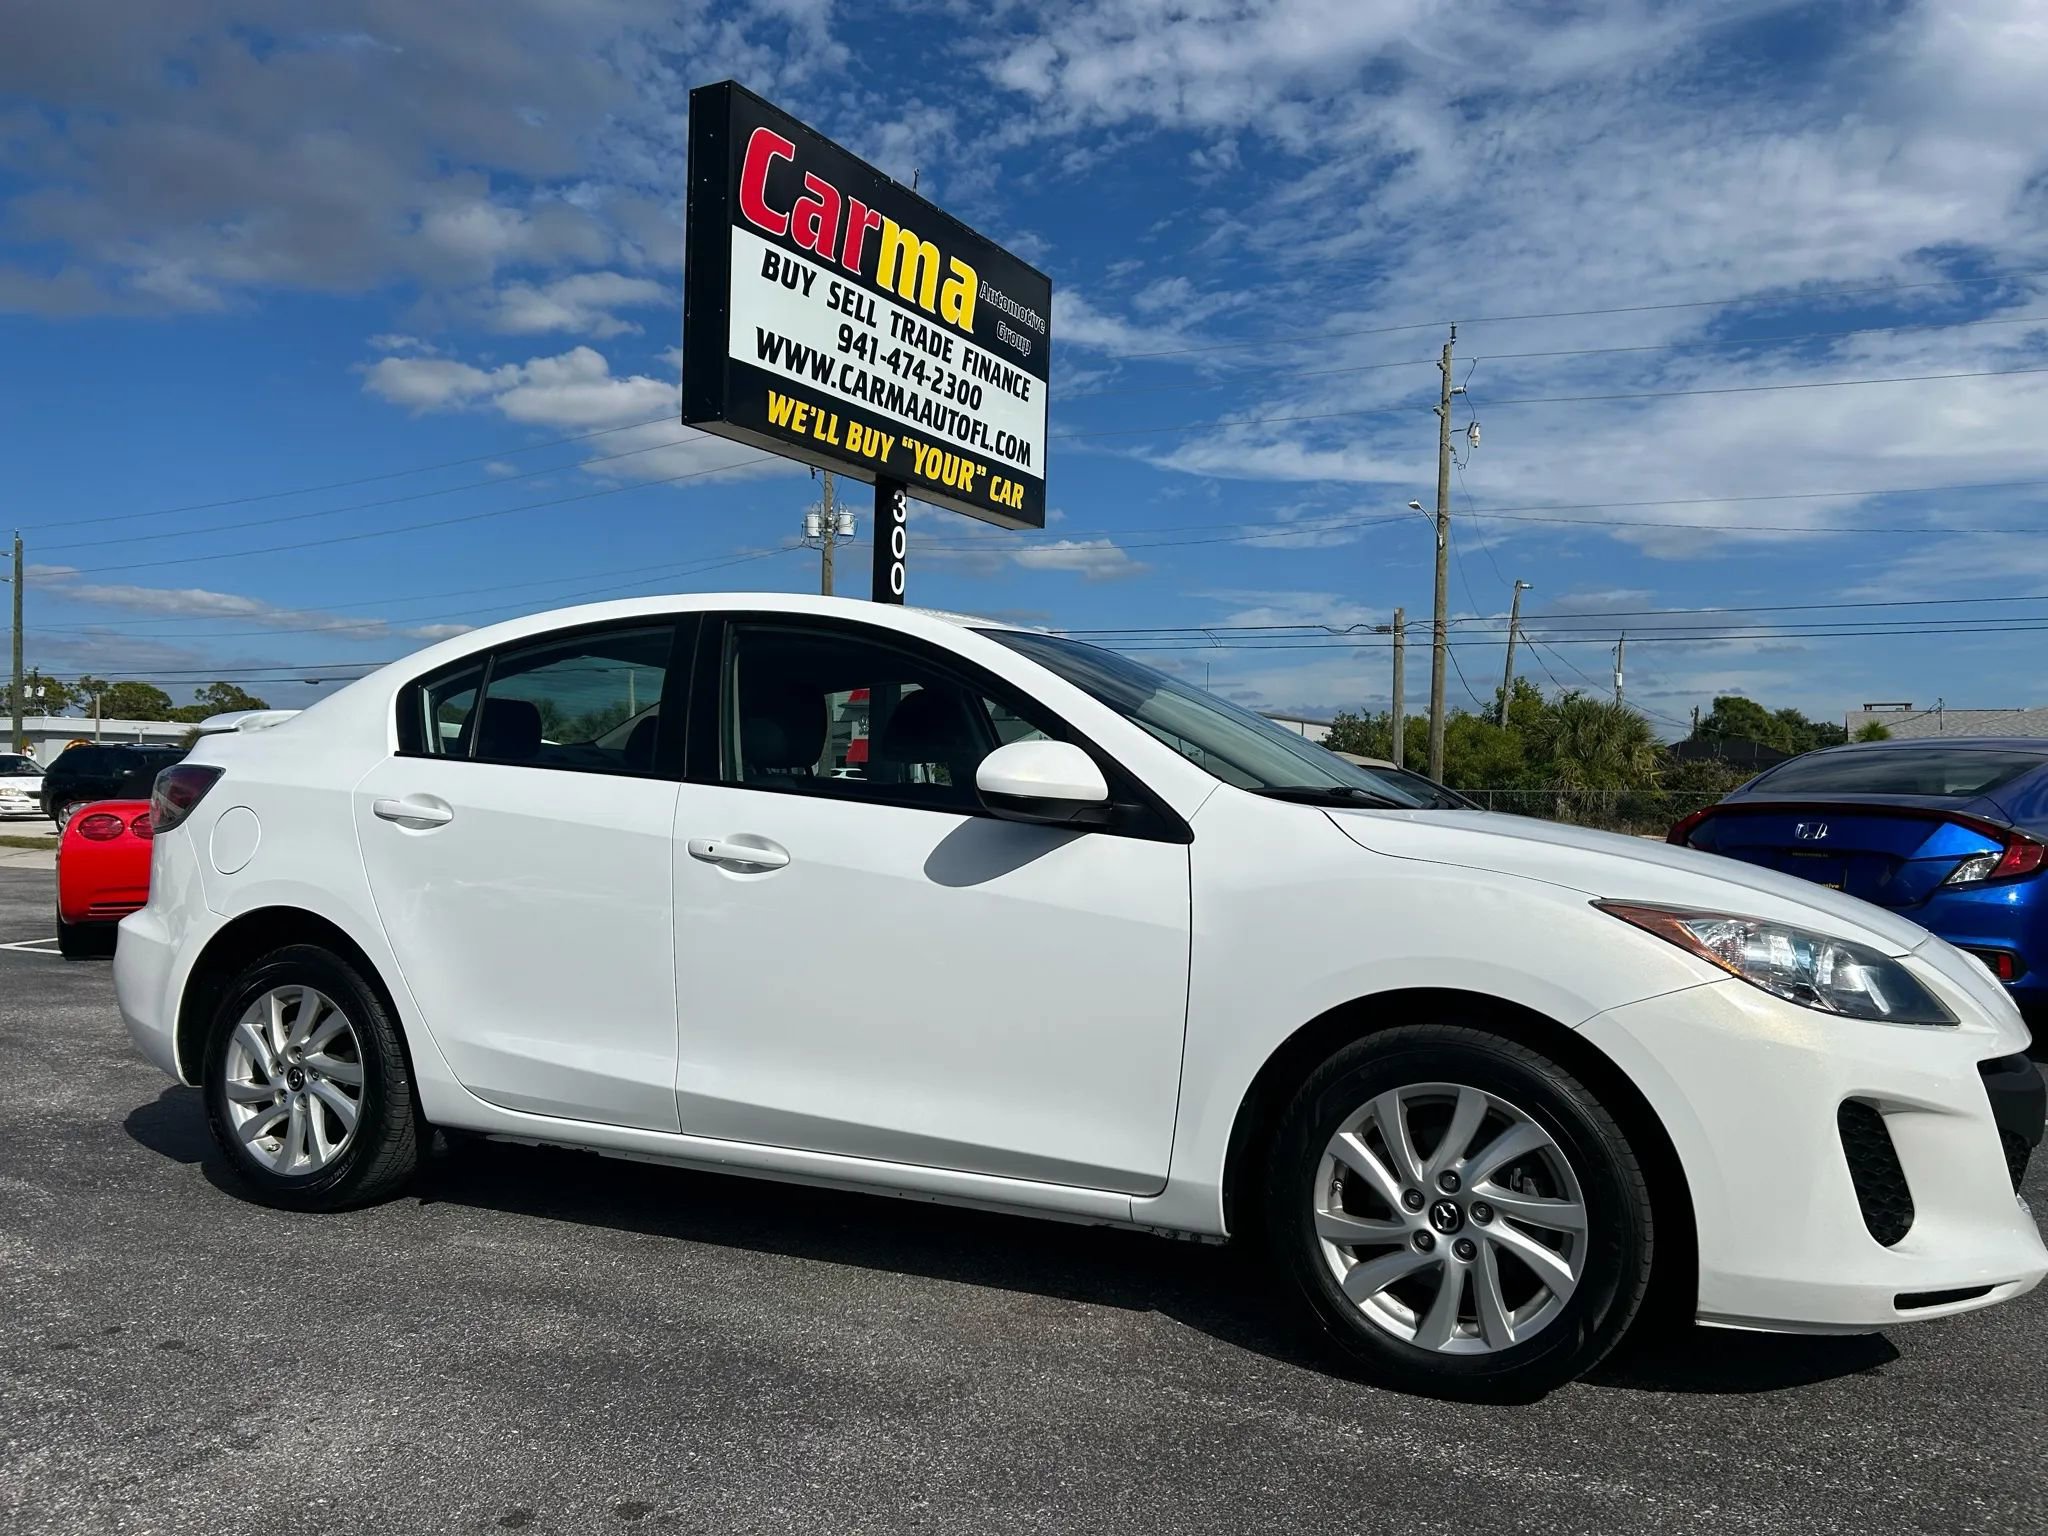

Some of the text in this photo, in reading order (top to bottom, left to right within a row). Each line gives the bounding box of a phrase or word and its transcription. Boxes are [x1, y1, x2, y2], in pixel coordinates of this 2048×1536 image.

[739, 126, 979, 334] Carma
[760, 248, 1031, 402] BUY SELL TRADE FINANCE
[979, 280, 1046, 335] Automotive
[996, 320, 1032, 357] Group
[755, 326, 1032, 468] WWW.CARMAAUTOFL.COM
[837, 323, 983, 411] 941-474-2300
[767, 390, 840, 446] WE'LL
[845, 420, 895, 463] BUY
[989, 475, 1025, 510] CAR
[890, 489, 907, 596] 300
